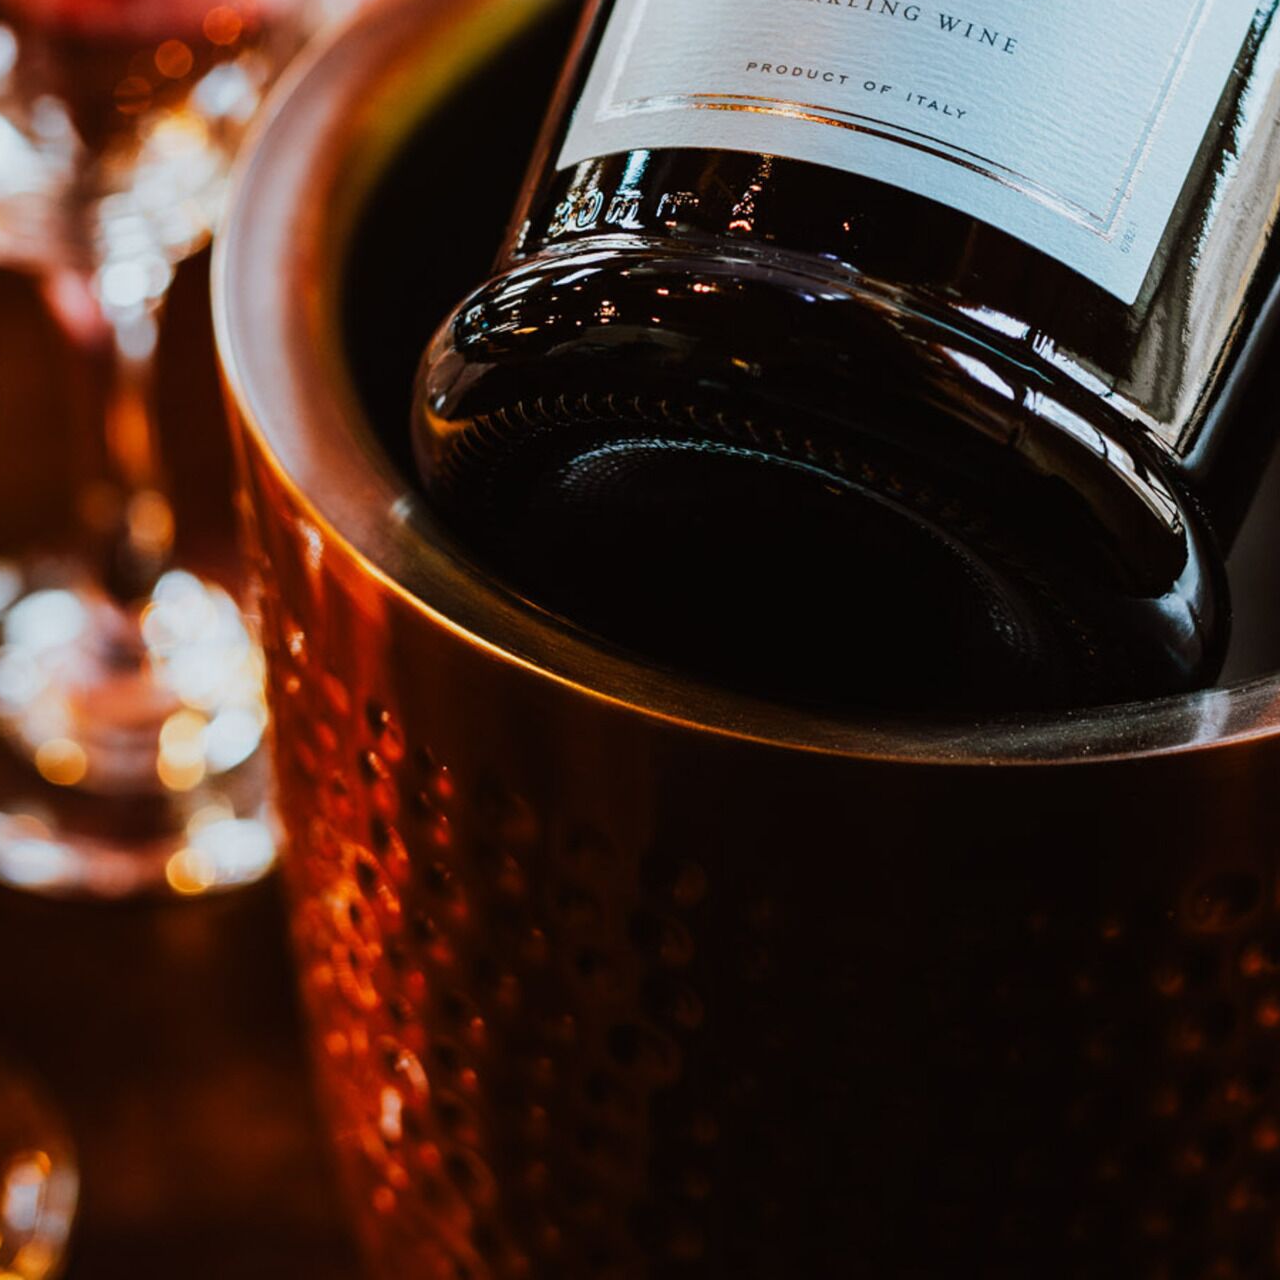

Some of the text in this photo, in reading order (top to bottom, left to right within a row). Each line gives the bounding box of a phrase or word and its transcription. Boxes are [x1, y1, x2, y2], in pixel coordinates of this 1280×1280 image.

[937, 13, 1018, 55] WINE
[745, 61, 967, 119] PRODUCT OF ITALY
